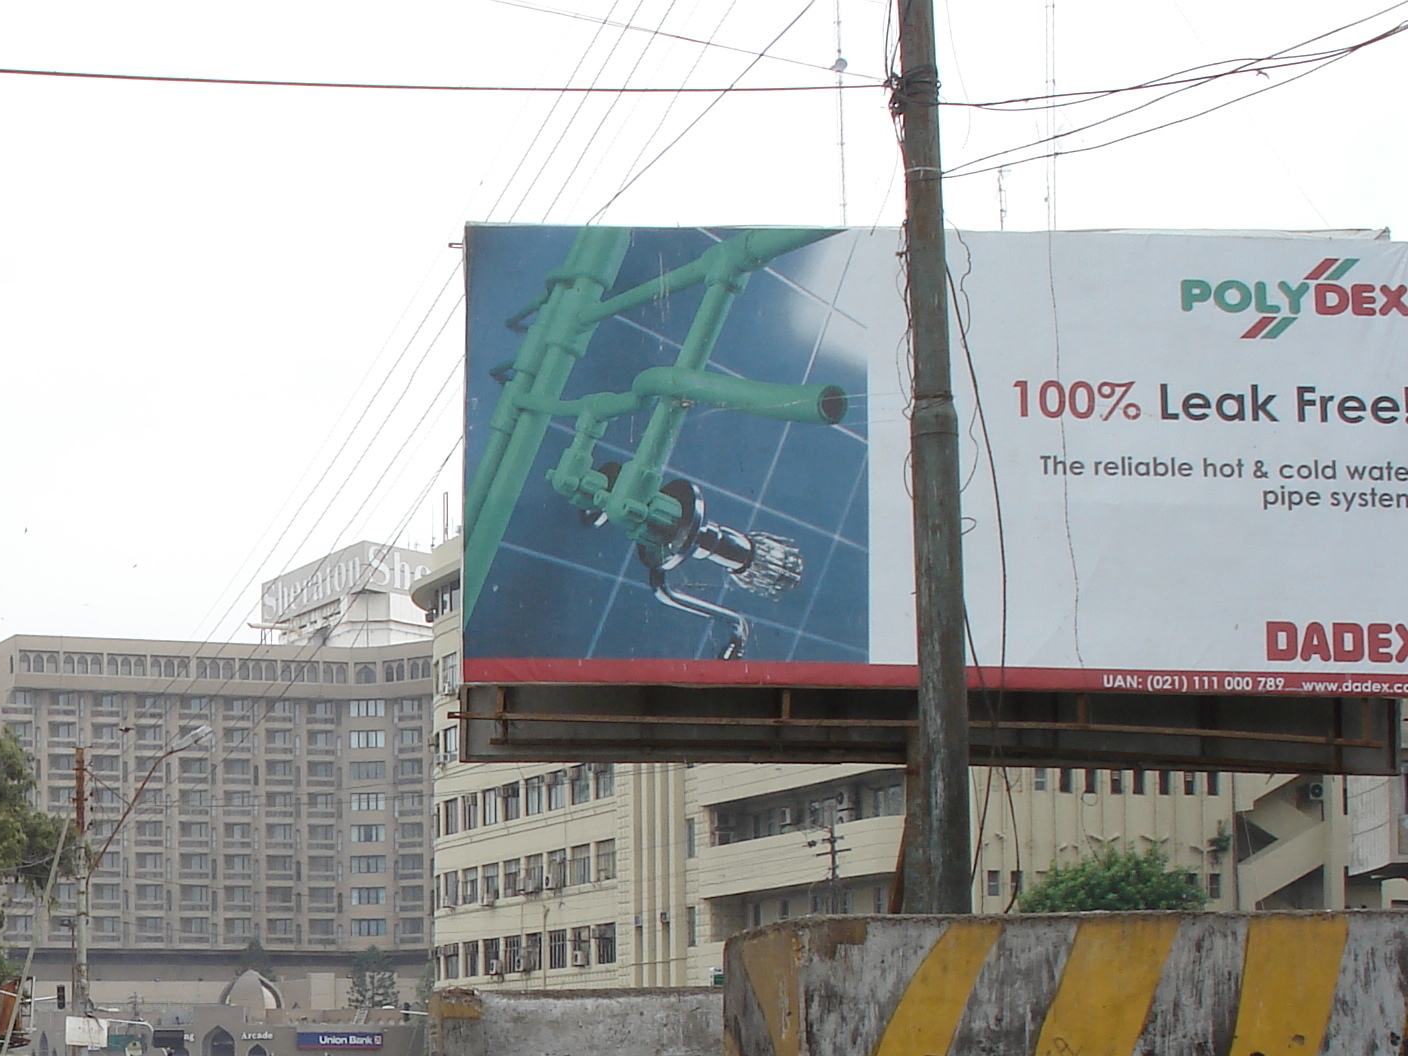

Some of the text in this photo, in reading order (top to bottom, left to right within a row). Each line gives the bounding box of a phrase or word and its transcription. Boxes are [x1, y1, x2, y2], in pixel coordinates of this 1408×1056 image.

[1180, 279, 1408, 317] POLYDEX
[1013, 380, 1141, 421] 100%
[1159, 383, 1280, 422] Leak
[1039, 454, 1085, 476] The
[1093, 456, 1193, 477] reliable
[1202, 458, 1244, 479] hot
[1252, 460, 1269, 479] &
[1278, 460, 1337, 480] cold
[1262, 486, 1321, 511] pipe
[263, 555, 362, 621] Sheraton
[1103, 674, 1143, 689] UAN:
[1146, 675, 1188, 693] (021)
[1192, 676, 1219, 690] 111
[1224, 677, 1252, 691] 000
[1257, 678, 1285, 691] 789
[241, 1031, 274, 1040] Arcade
[318, 1035, 373, 1045] Union Bank
